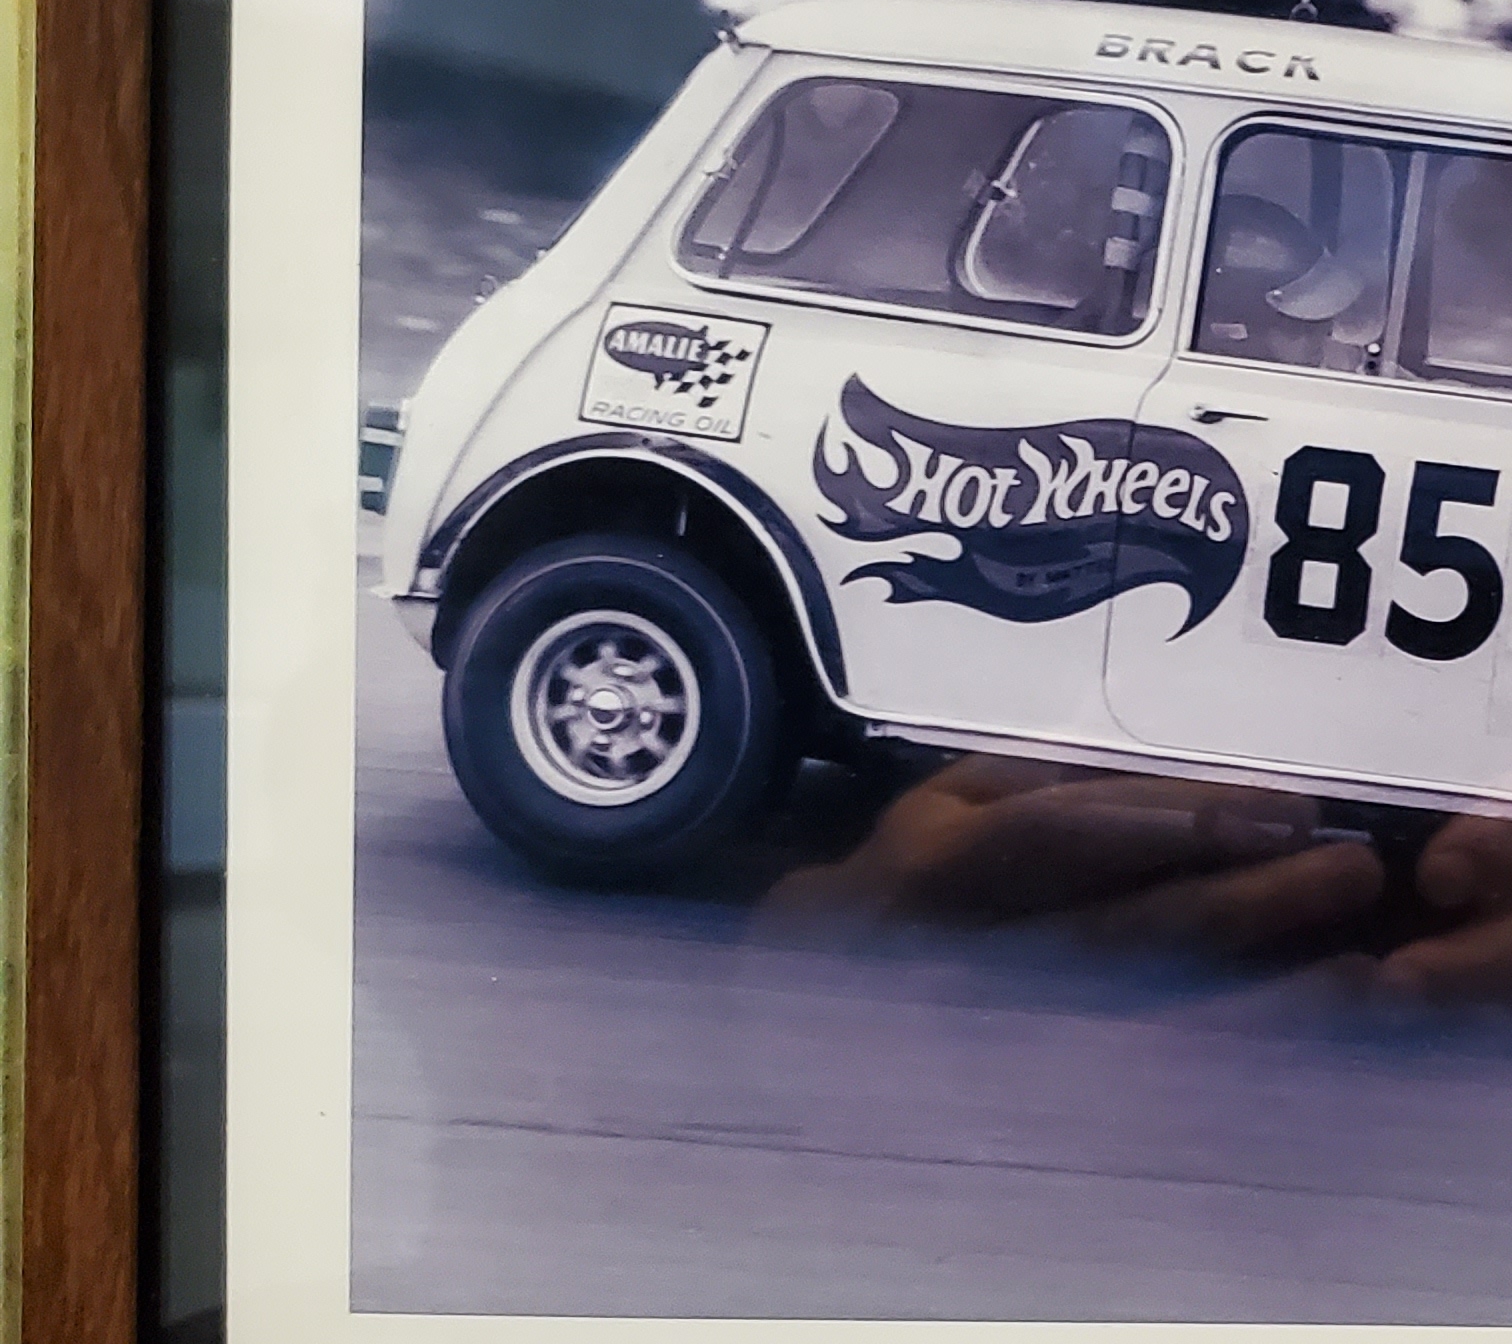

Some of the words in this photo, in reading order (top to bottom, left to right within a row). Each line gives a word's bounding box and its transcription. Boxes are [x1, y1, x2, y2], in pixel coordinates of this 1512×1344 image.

[1096, 33, 1320, 81] BRACK
[608, 328, 707, 362] AMALIE
[590, 401, 687, 428] RACING
[694, 415, 733, 435] OIL
[1263, 445, 1504, 661] 85
